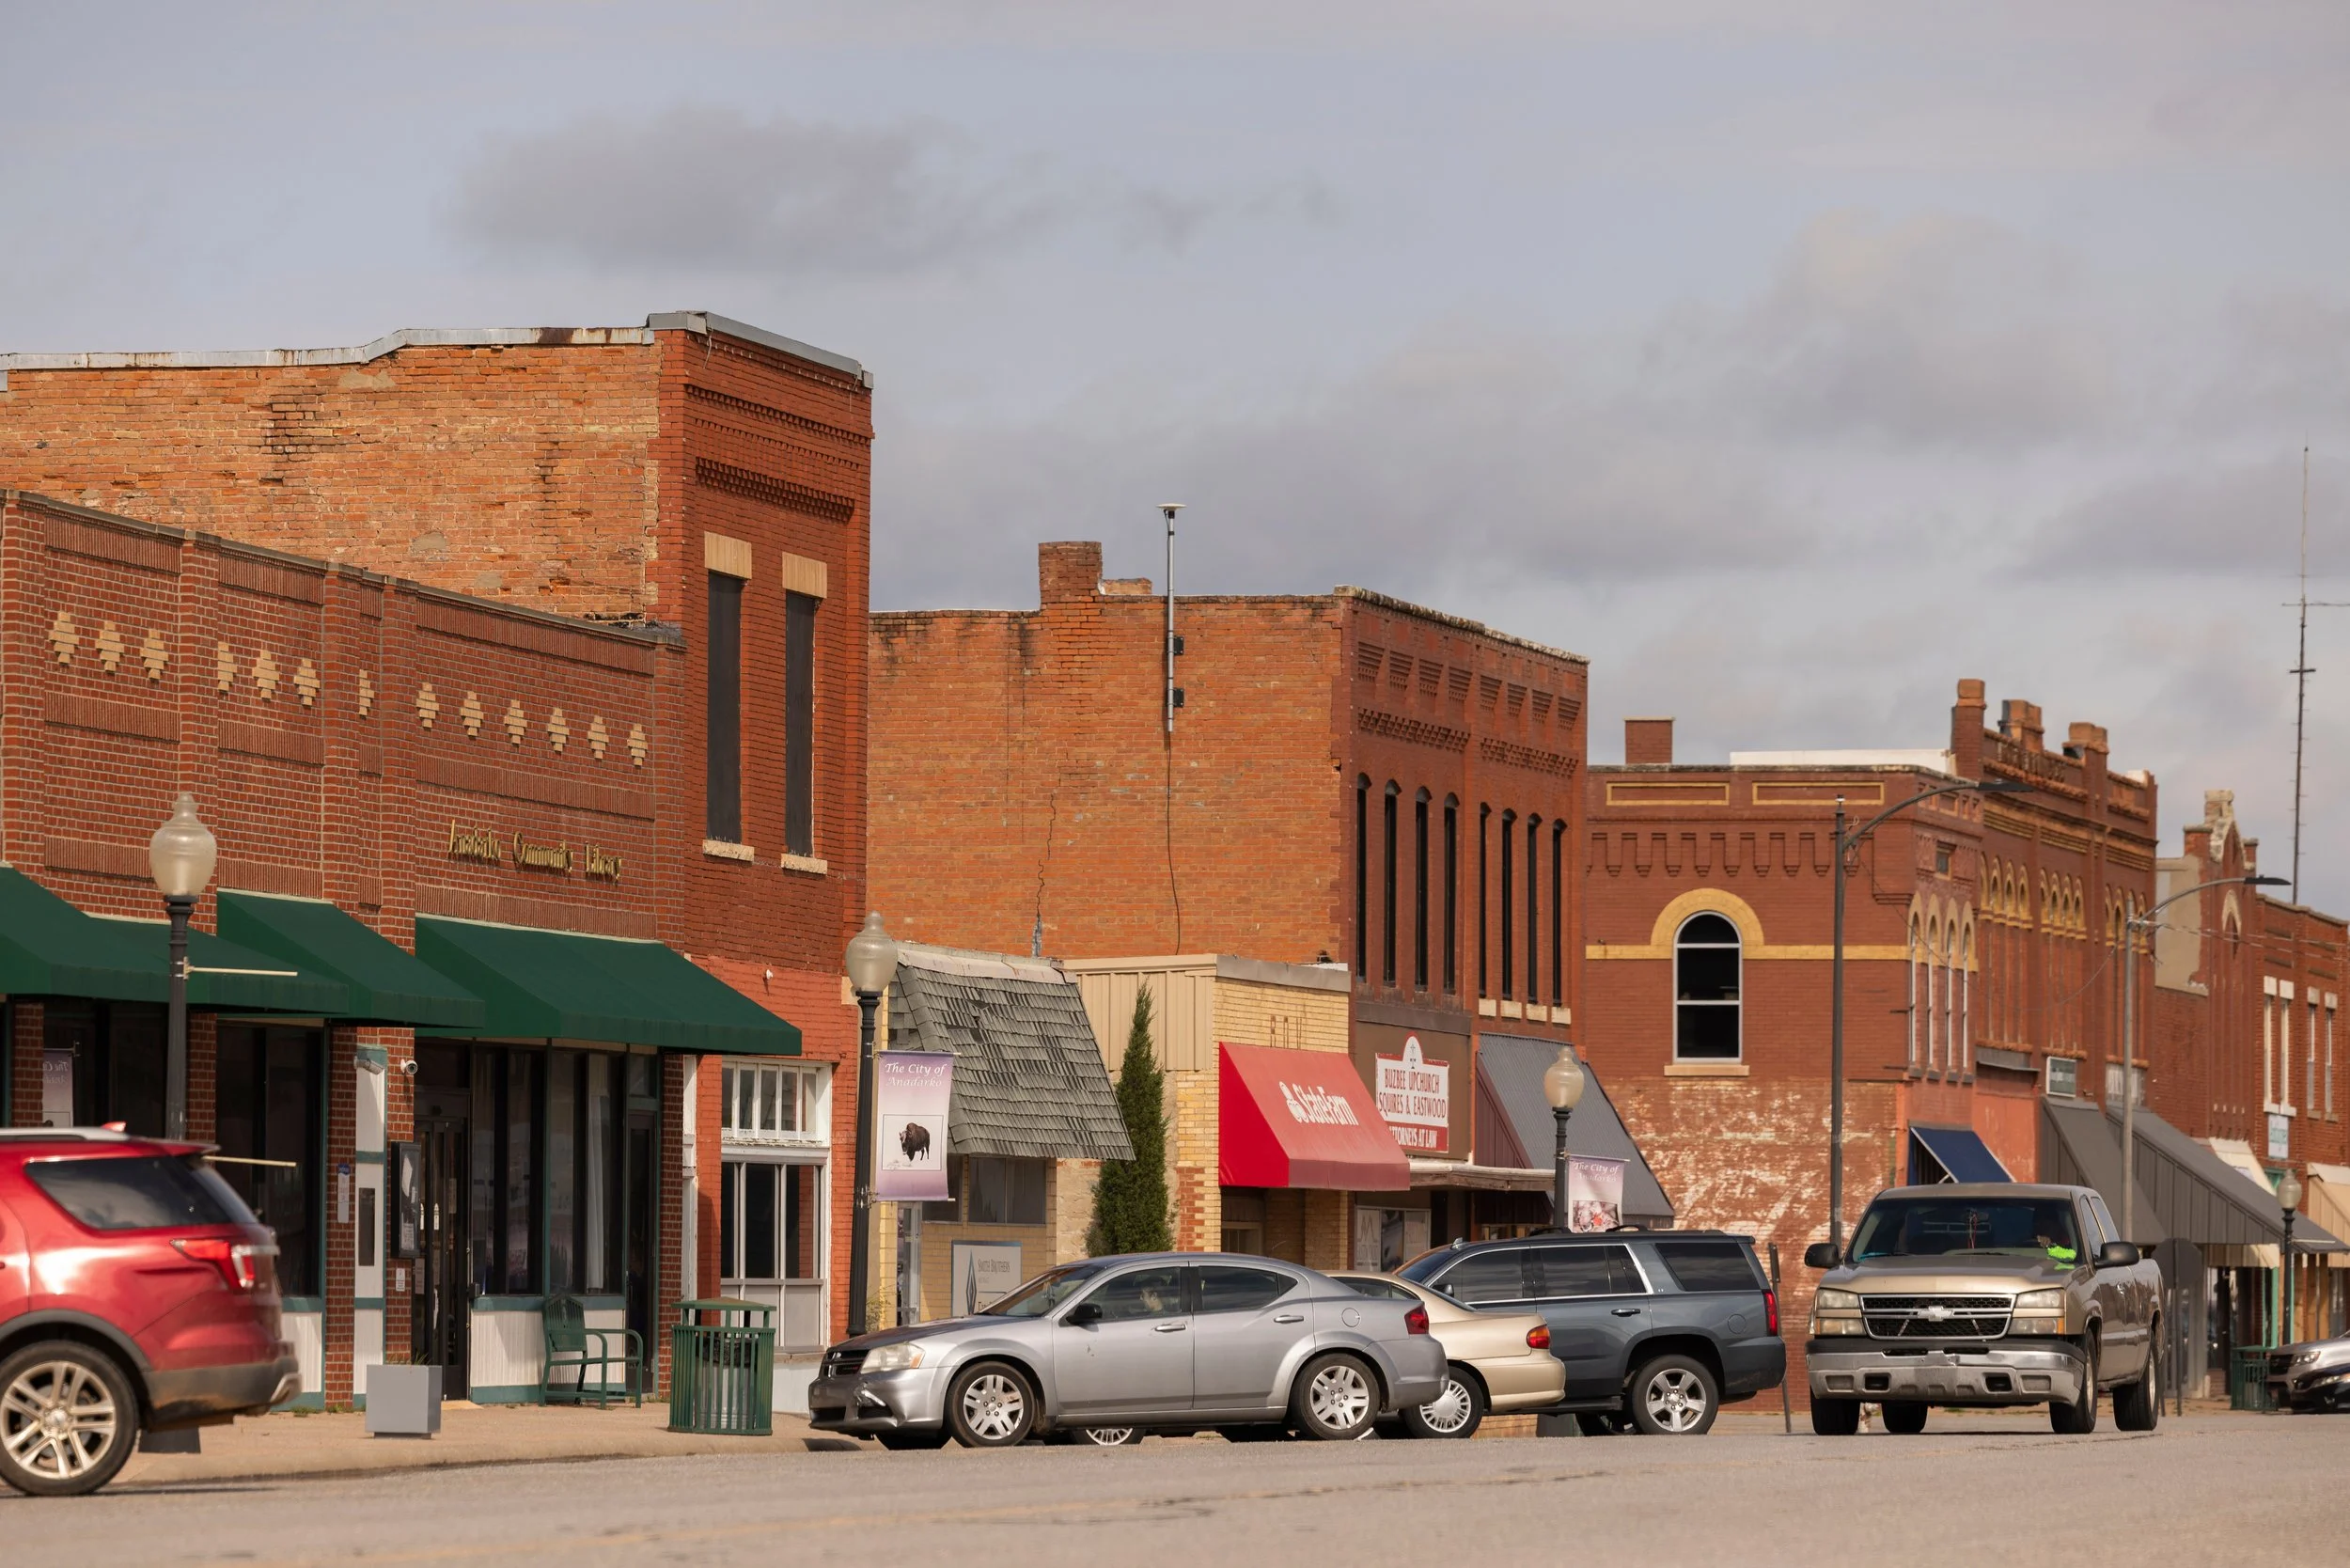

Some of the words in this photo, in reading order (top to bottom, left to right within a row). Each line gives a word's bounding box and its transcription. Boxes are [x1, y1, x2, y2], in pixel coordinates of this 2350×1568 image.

[513, 831, 573, 872] Community
[586, 841, 621, 880] Library
[885, 1062, 904, 1074] The
[908, 1063, 932, 1076] City
[934, 1063, 948, 1077] of
[886, 1076, 943, 1088] Anadarko
[1385, 1068, 1406, 1090] BUZBEE
[1408, 1071, 1440, 1094] UPCHURCH
[1379, 1091, 1403, 1117] SQUIRES
[1406, 1094, 1411, 1115] &
[1414, 1095, 1447, 1119] EASTWOOD
[1418, 1128, 1425, 1147] AT
[1426, 1129, 1437, 1148] LAW
[1574, 1161, 1589, 1170] The
[1590, 1163, 1608, 1173] City
[1609, 1165, 1620, 1174] of
